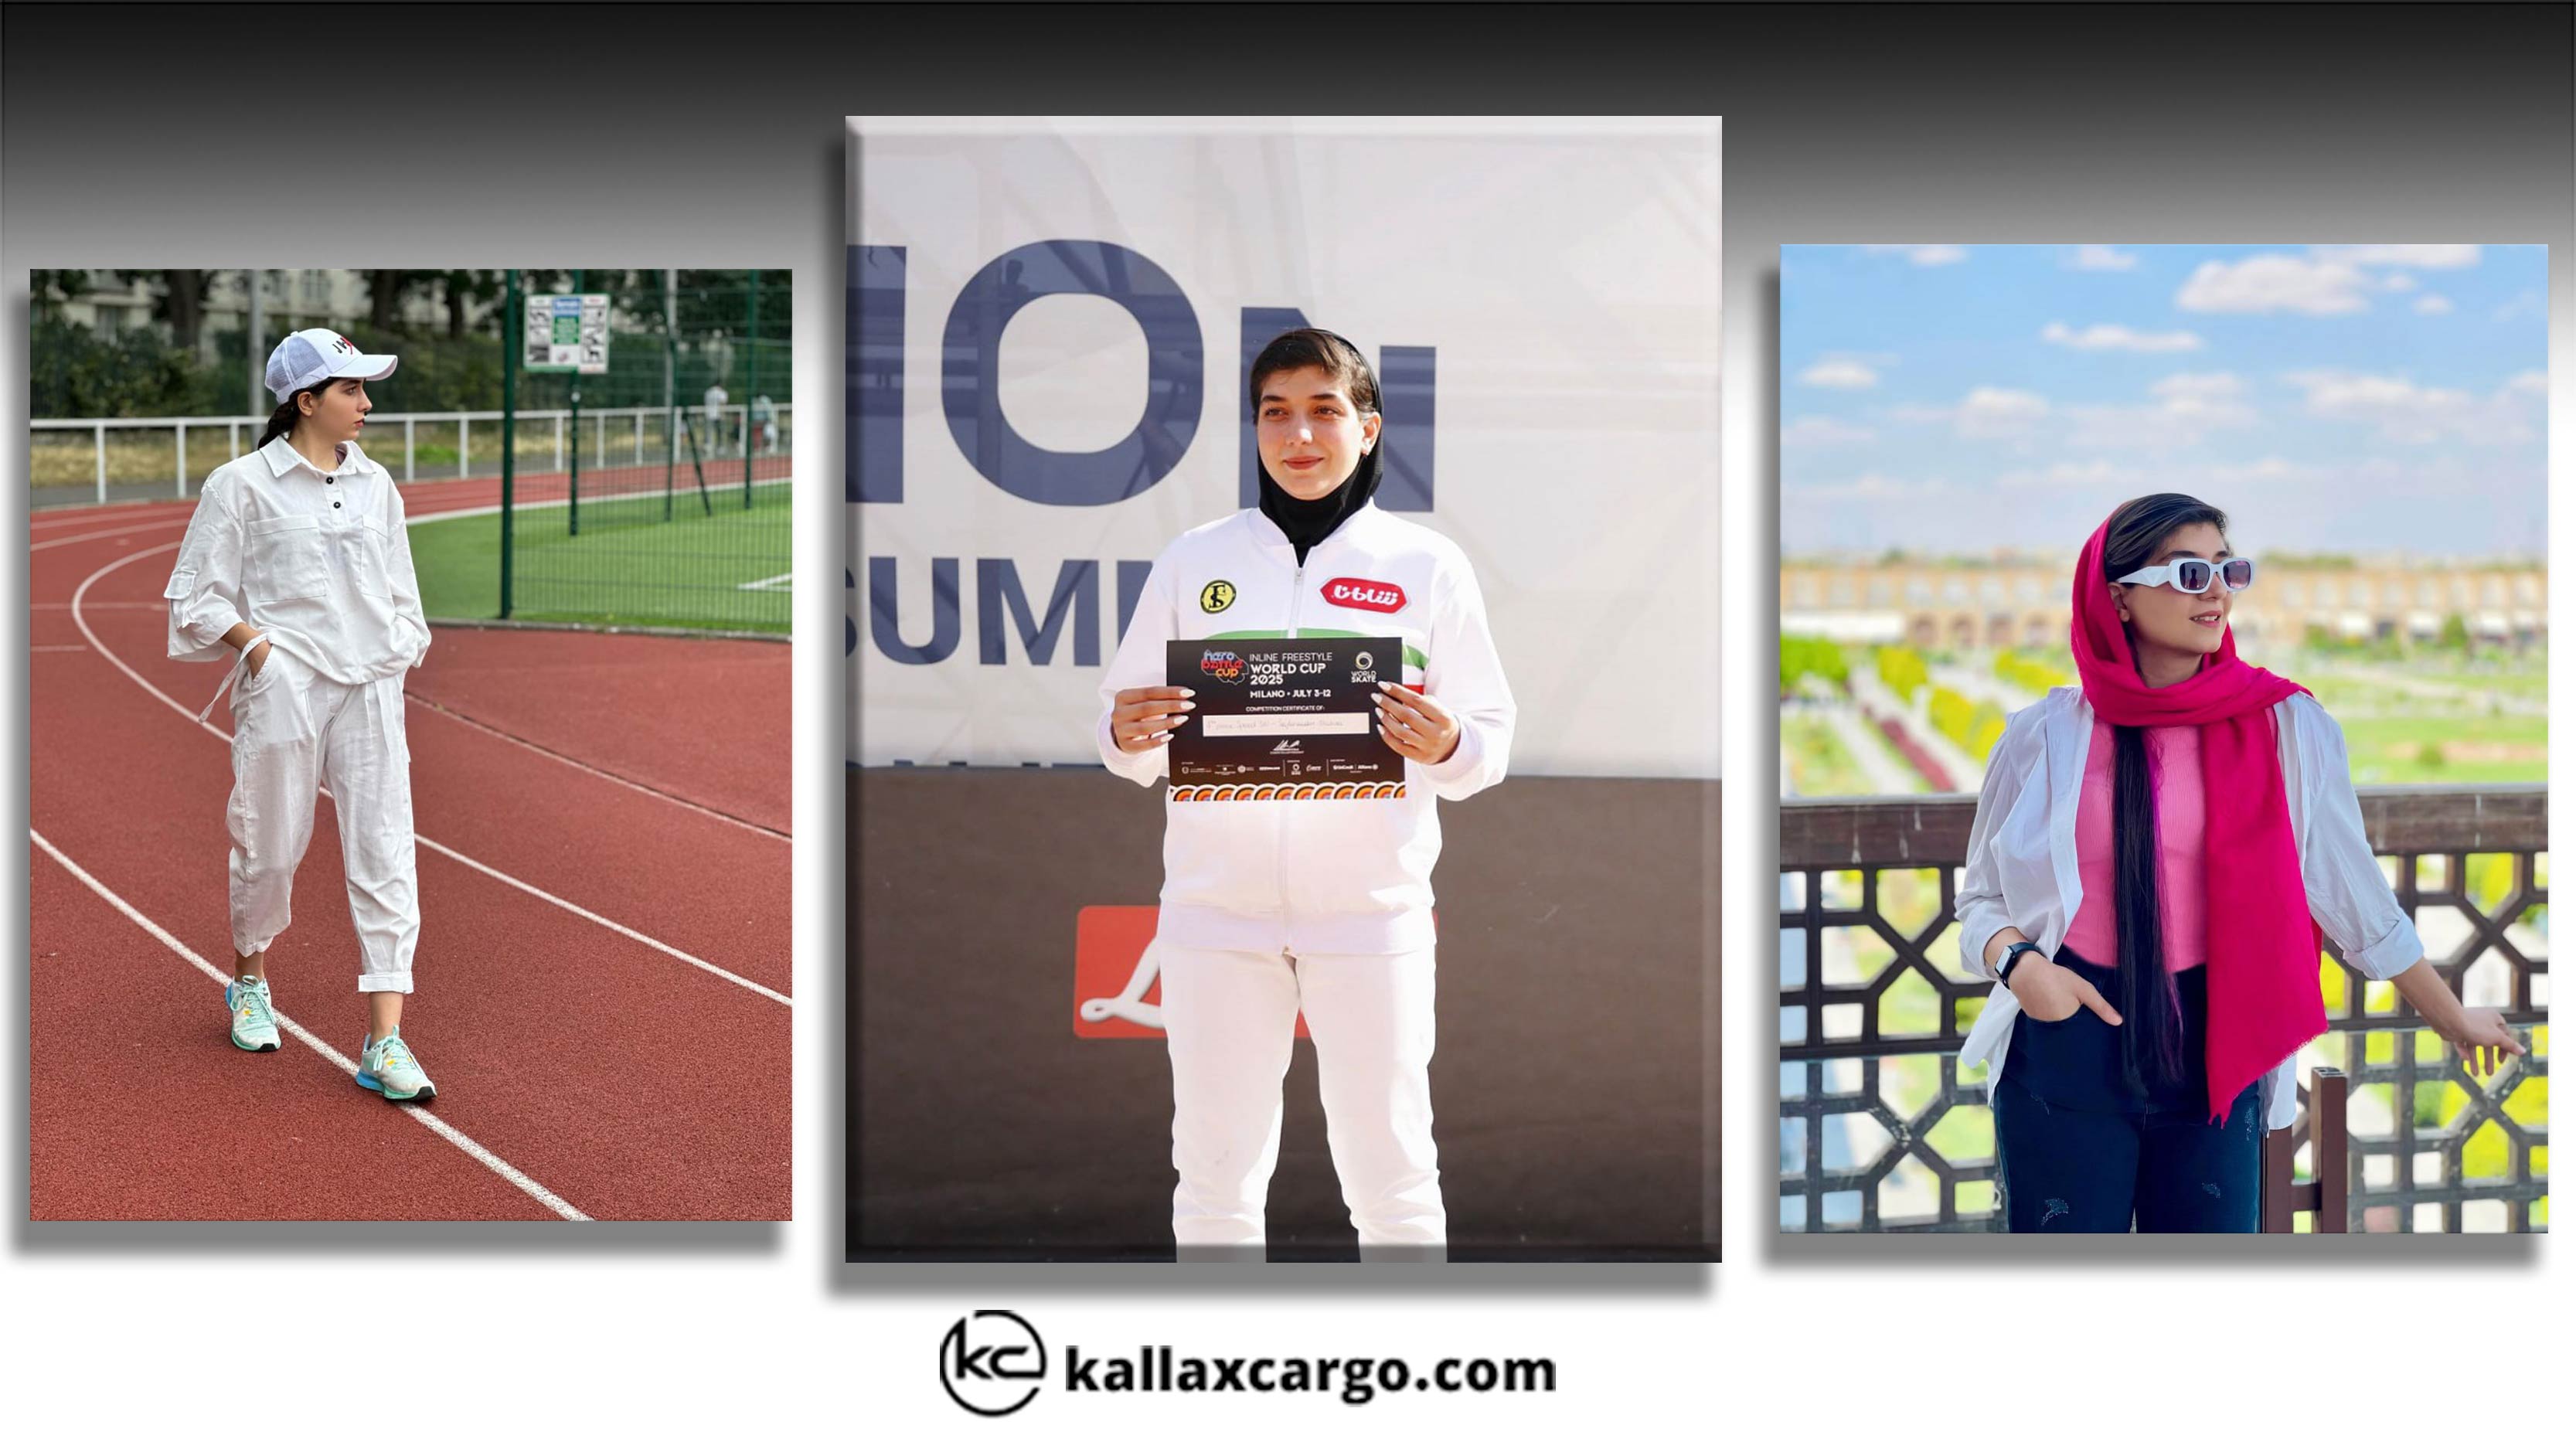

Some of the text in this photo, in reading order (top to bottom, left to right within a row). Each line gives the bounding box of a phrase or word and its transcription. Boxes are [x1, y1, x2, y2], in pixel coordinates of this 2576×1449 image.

[846, 556, 1153, 666] UM
[1250, 652, 1332, 662] INLINE FREESTYLE
[1251, 662, 1326, 675] WORLD CUP
[1250, 674, 1284, 685] 2025
[1250, 689, 1332, 699] MILANO JULY 3-12
